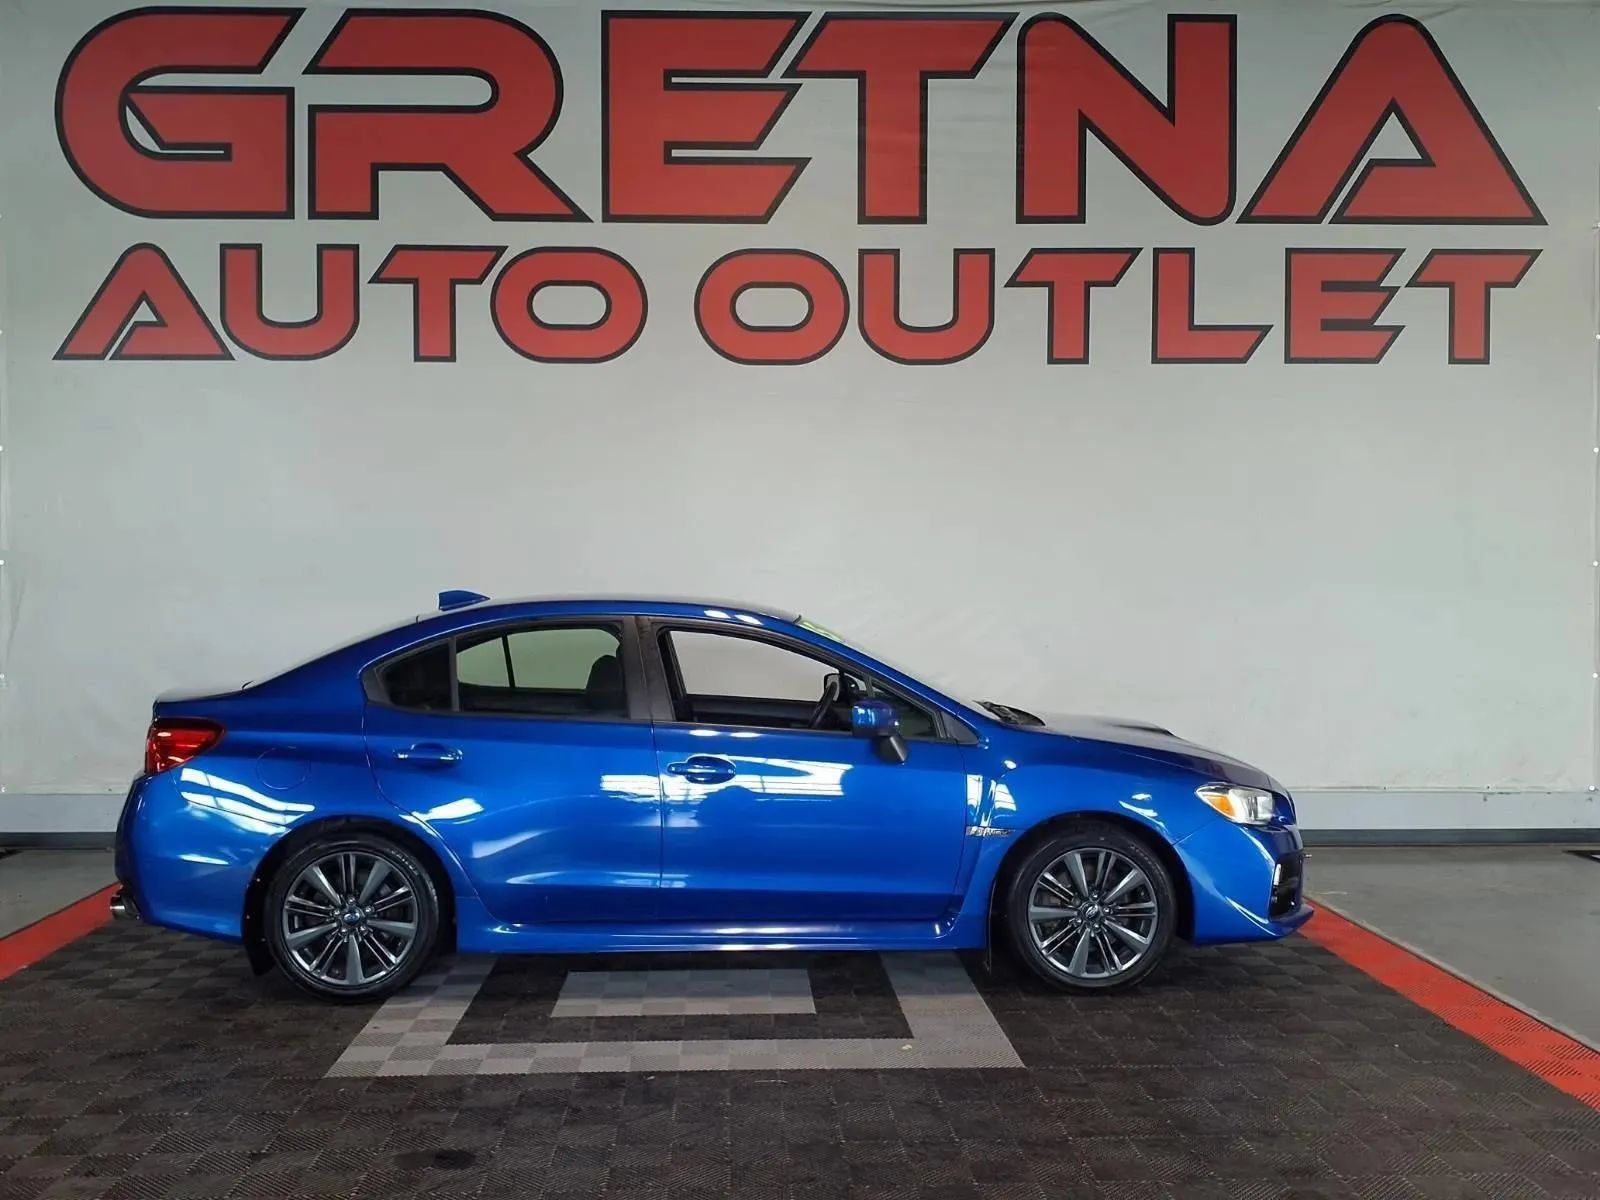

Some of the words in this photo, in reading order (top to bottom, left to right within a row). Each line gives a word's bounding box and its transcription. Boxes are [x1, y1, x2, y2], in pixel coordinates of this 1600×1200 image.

[55, 6, 1548, 226] GRETNA
[52, 243, 648, 363] AUTO
[694, 247, 1543, 365] OUTLET
